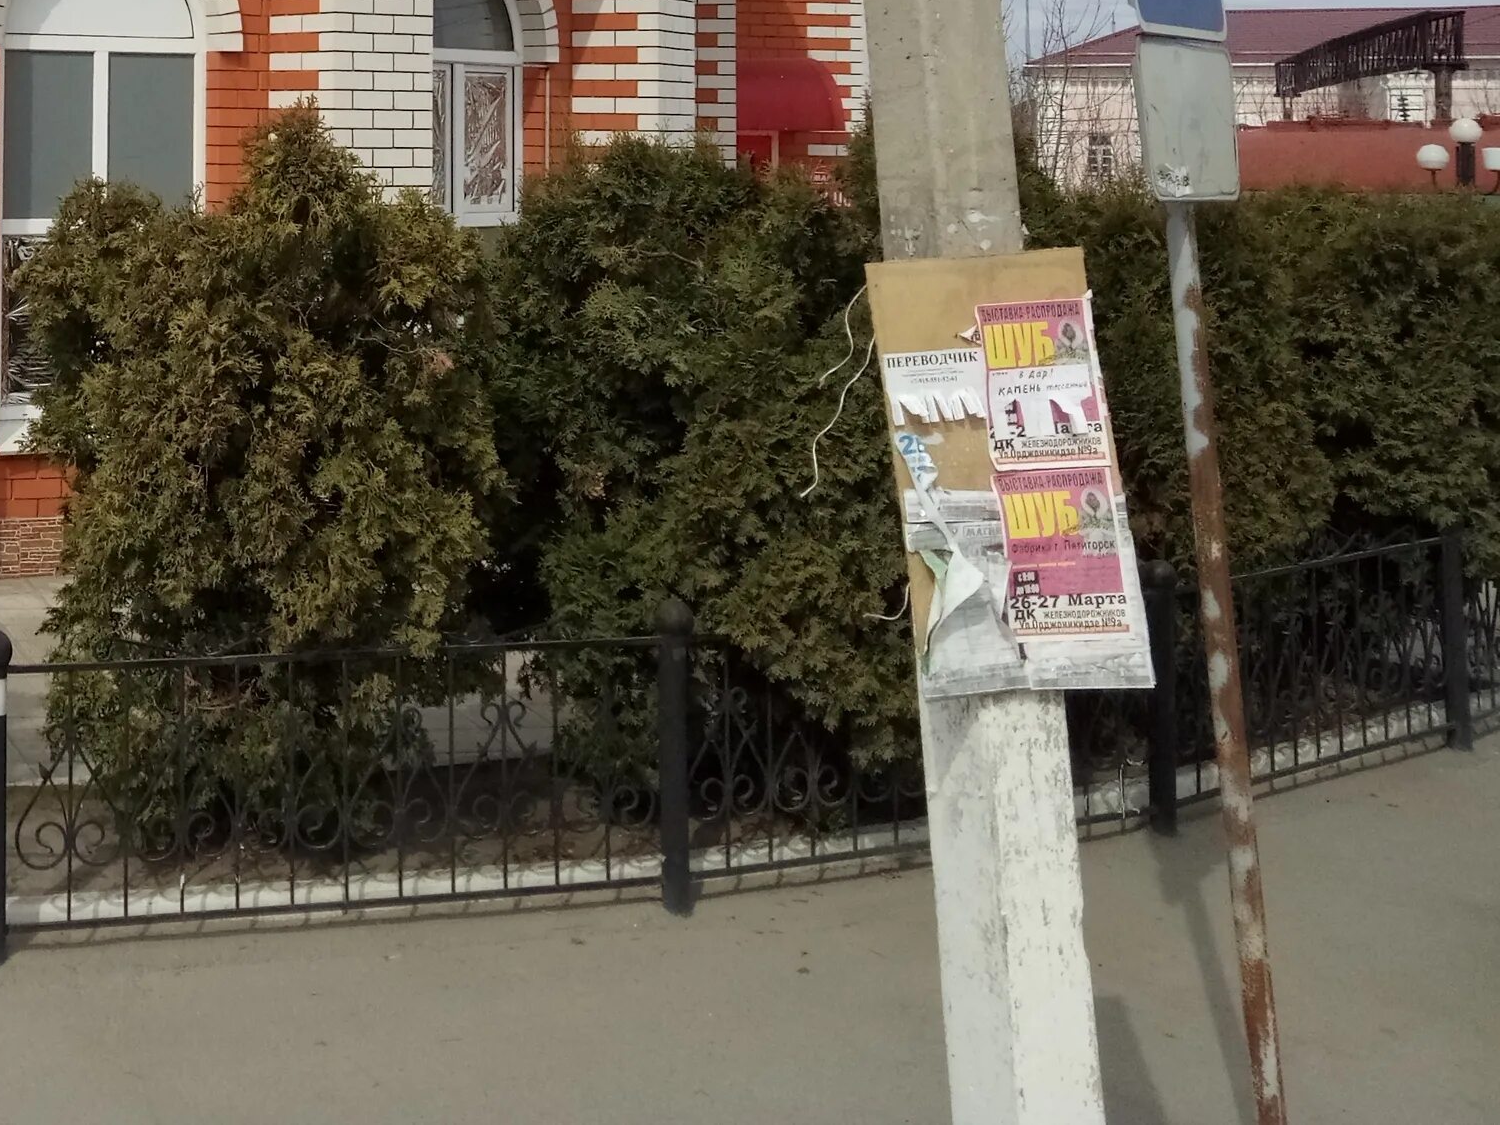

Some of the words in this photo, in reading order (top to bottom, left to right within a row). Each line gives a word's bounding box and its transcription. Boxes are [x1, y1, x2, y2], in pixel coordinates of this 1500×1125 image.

[983, 321, 1056, 368] ШУБ
[886, 351, 978, 368] ПЕРЕВОДЧИК
[994, 438, 1015, 452] ДК
[1002, 490, 1078, 539] ШУБ
[1010, 595, 1060, 609] 26-27
[1067, 593, 1127, 608] Марта
[1014, 609, 1036, 622] ДК
[1043, 608, 1126, 620] ЖЕЛЕЗНОДОРОЖНИКОВ
